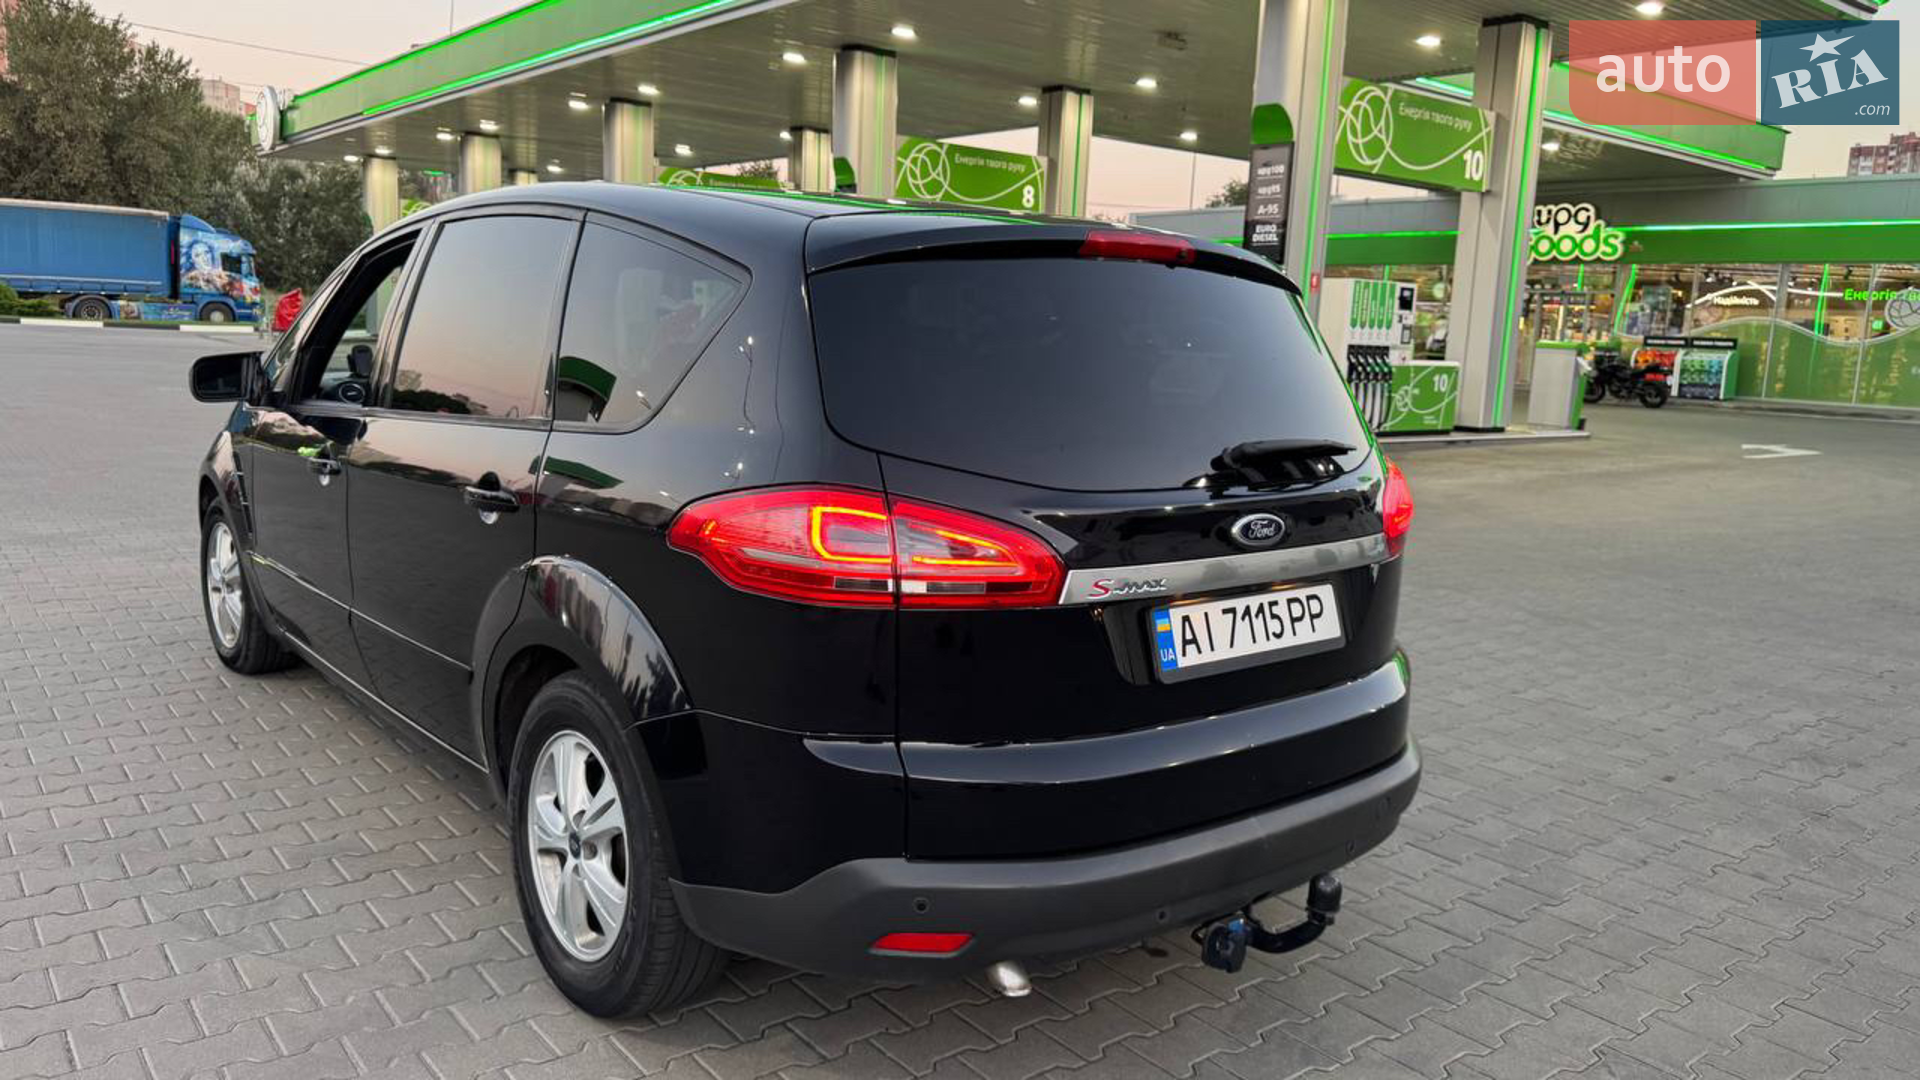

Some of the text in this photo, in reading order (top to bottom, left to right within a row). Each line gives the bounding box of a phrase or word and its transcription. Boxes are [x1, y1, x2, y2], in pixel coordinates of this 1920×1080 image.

[1463, 149, 1484, 180] 10
[1022, 185, 1035, 208] 8
[1255, 224, 1277, 233] EURO
[1535, 205, 1593, 235] upg
[1252, 233, 1279, 242] DIESEL
[1433, 374, 1448, 393] 10
[1248, 519, 1279, 539] Ford
[1181, 593, 1325, 658] AI 7115 PP
[1161, 646, 1176, 662] UA
